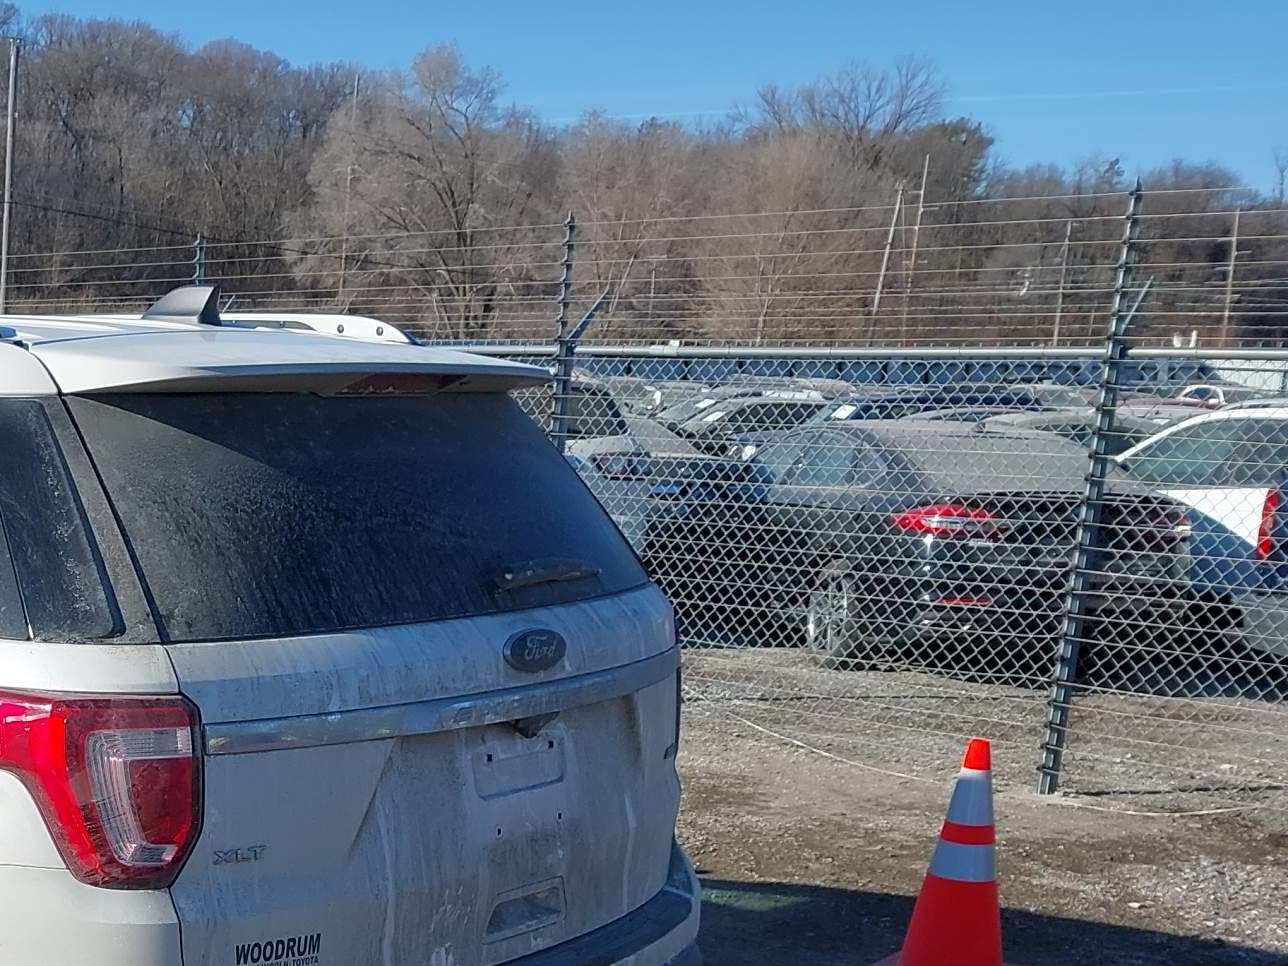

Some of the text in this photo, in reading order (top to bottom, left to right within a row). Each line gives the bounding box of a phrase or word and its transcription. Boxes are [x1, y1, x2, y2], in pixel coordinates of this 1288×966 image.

[524, 636, 558, 661] Ford
[213, 844, 267, 865] XLT
[235, 933, 321, 966] WOODRUM
